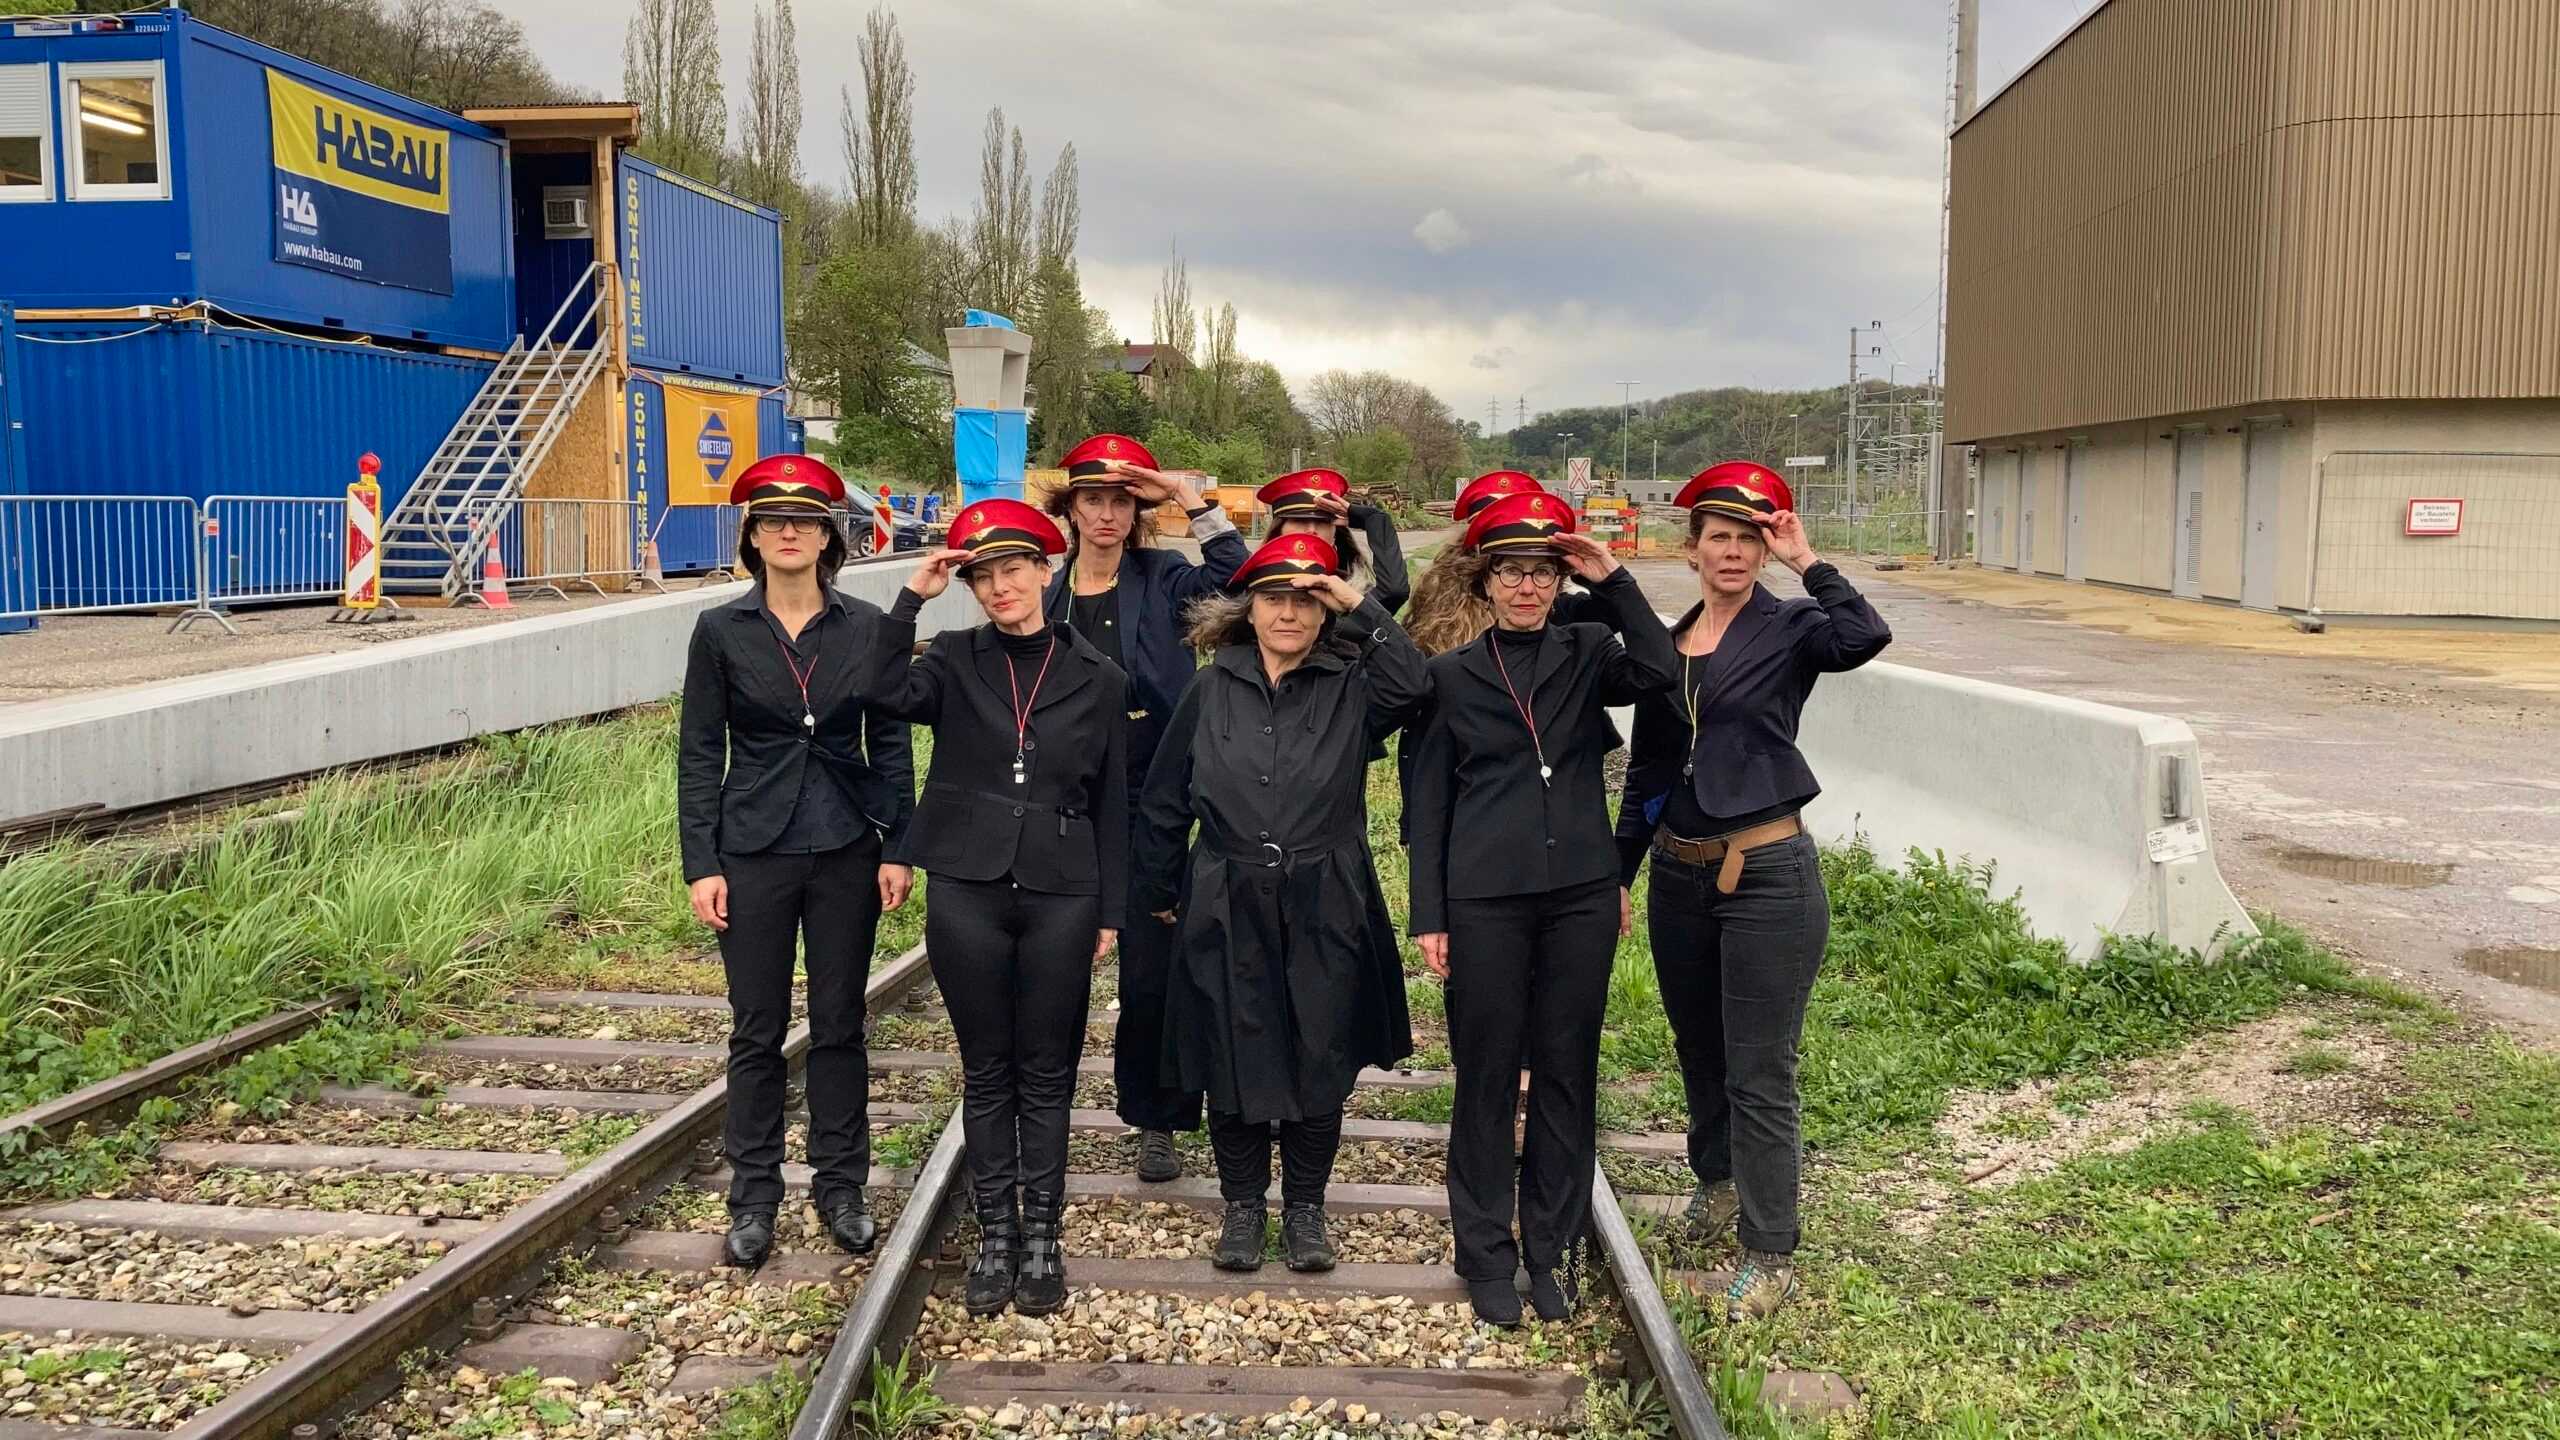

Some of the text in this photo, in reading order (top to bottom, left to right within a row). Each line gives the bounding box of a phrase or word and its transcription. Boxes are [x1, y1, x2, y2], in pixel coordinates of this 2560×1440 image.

[314, 104, 442, 195] HABAU
[283, 241, 362, 271] www.habau.com
[627, 176, 642, 327] CONTAINEX
[662, 375, 761, 397] www.containex.com
[699, 439, 731, 456] SWIETELSKY
